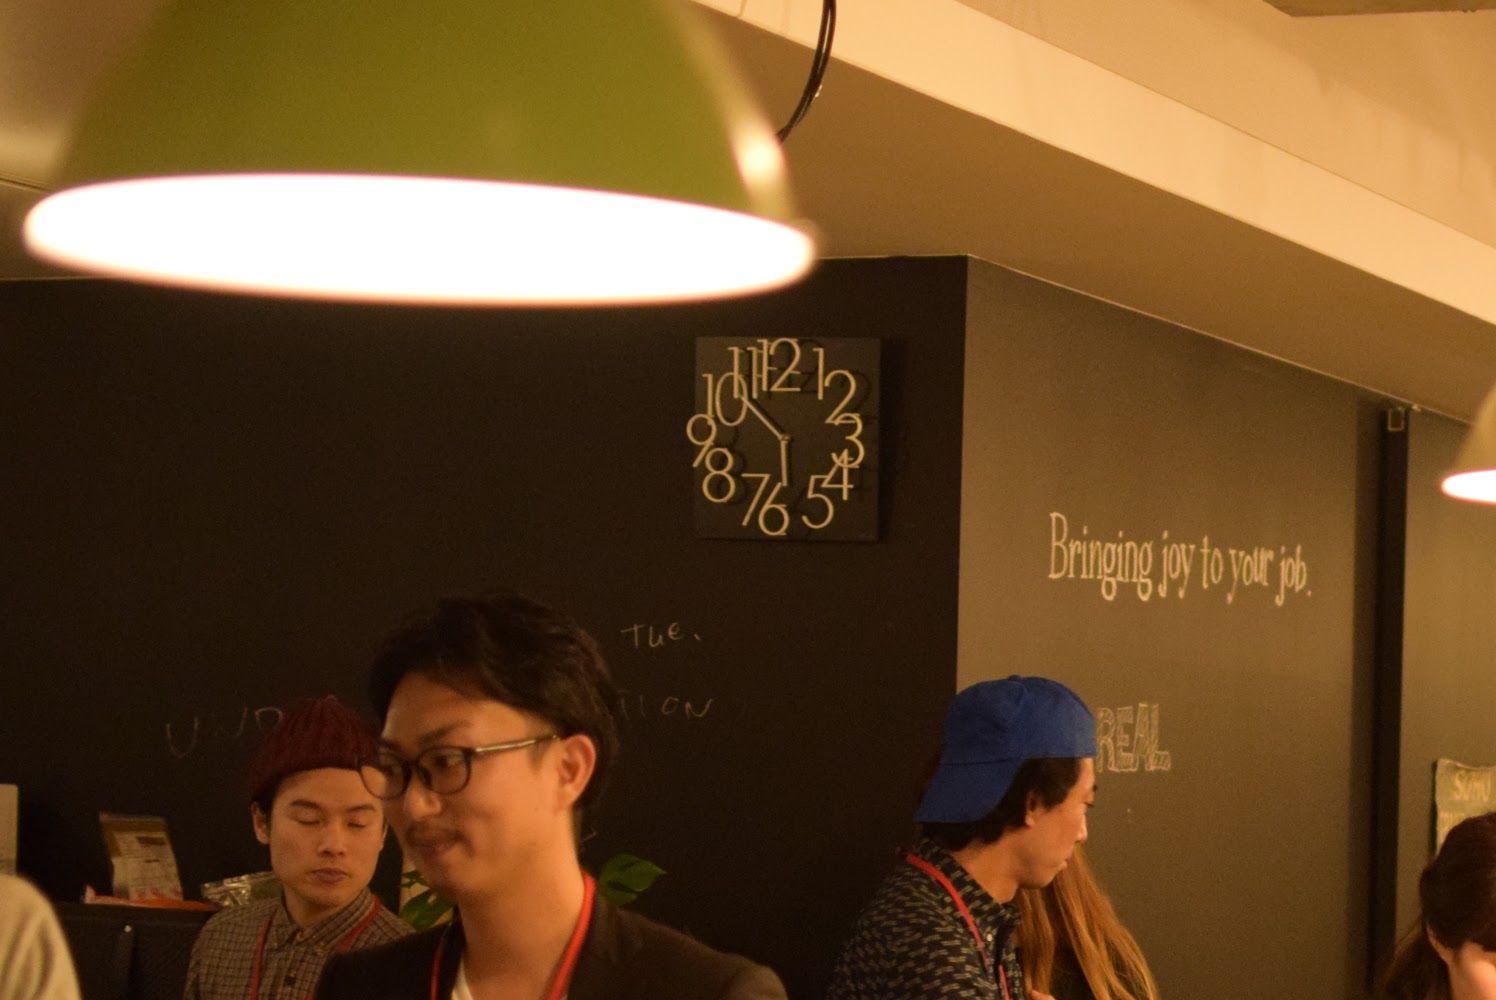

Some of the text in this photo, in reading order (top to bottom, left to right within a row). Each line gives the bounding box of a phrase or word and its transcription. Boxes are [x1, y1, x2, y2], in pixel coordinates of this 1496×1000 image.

[728, 346, 759, 399] 11
[757, 338, 801, 392] 12
[813, 347, 825, 401] 1
[702, 372, 748, 427] 10
[824, 369, 857, 424] 2
[686, 413, 717, 468] 9
[833, 413, 865, 469] 3
[702, 447, 736, 503] 8
[741, 473, 772, 527] 7
[820, 448, 854, 501] 4
[758, 483, 790, 536] 6
[802, 475, 834, 530] 5
[1049, 511, 1312, 607] Bringing joy to your job.
[1095, 702, 1172, 774] REAL
